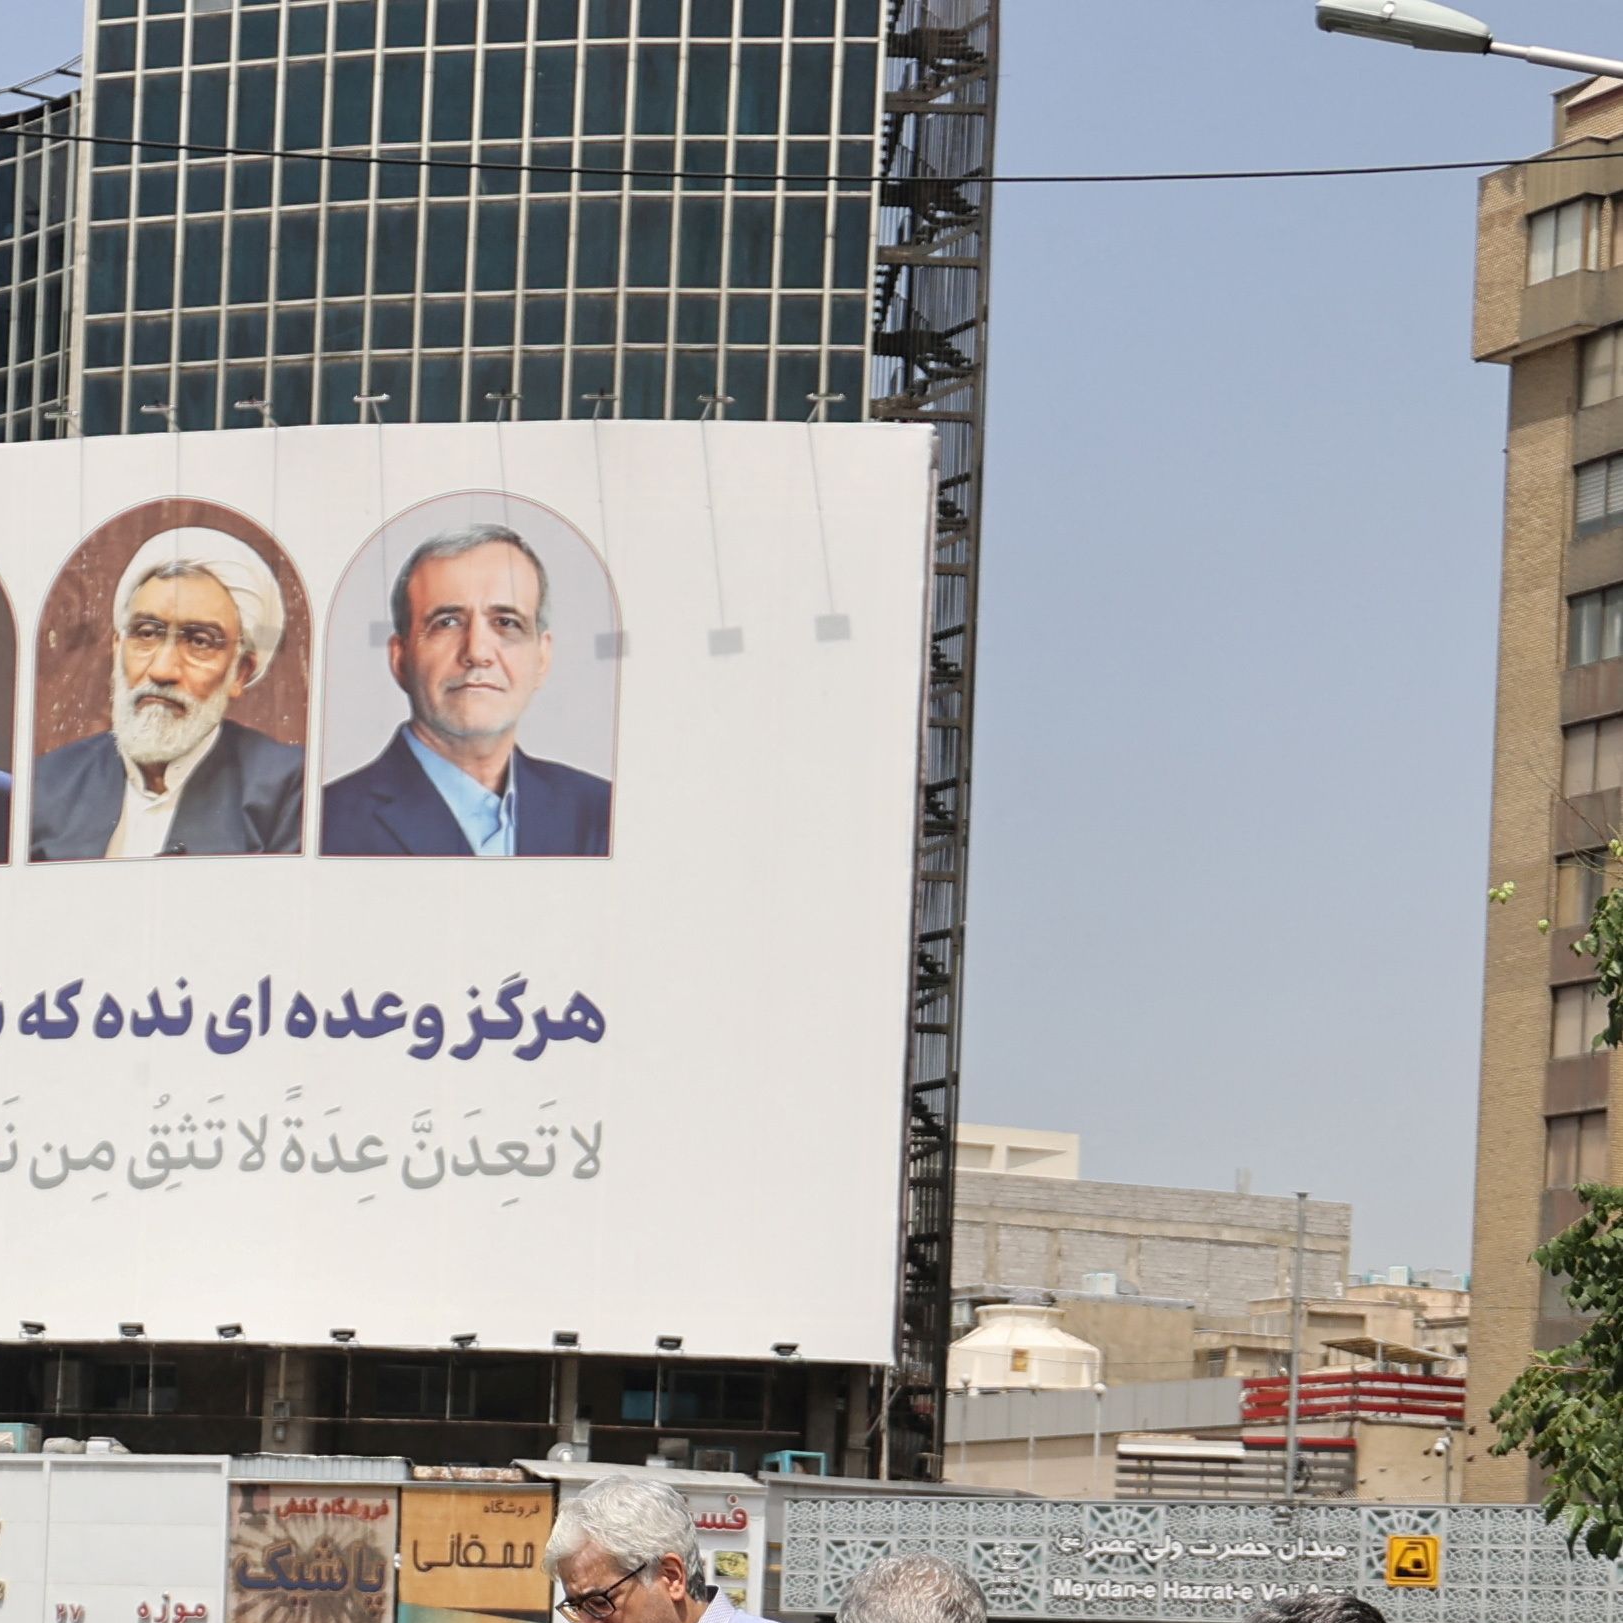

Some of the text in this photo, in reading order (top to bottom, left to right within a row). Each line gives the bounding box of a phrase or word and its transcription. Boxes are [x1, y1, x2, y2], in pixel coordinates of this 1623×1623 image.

[18, 978, 84, 1041] که
[92, 976, 194, 1040] نده
[205, 973, 272, 1055] ای
[284, 986, 446, 1060] وعده
[448, 970, 607, 1062] هرگز
[235, 1112, 270, 1174] لا
[569, 1119, 604, 1181] لا
[275, 1496, 390, 1520] فروشگاه کفش
[483, 1499, 542, 1516] فروشگاه
[694, 1494, 749, 1532] فس
[1084, 1538, 1140, 1558] عصر
[1142, 1534, 1184, 1562] ولی
[1188, 1536, 1271, 1561] حضرت
[1277, 1537, 1348, 1562] میدان
[1053, 1577, 1156, 1601] Meydan-e
[1163, 1579, 1253, 1601] Hazrat-e
